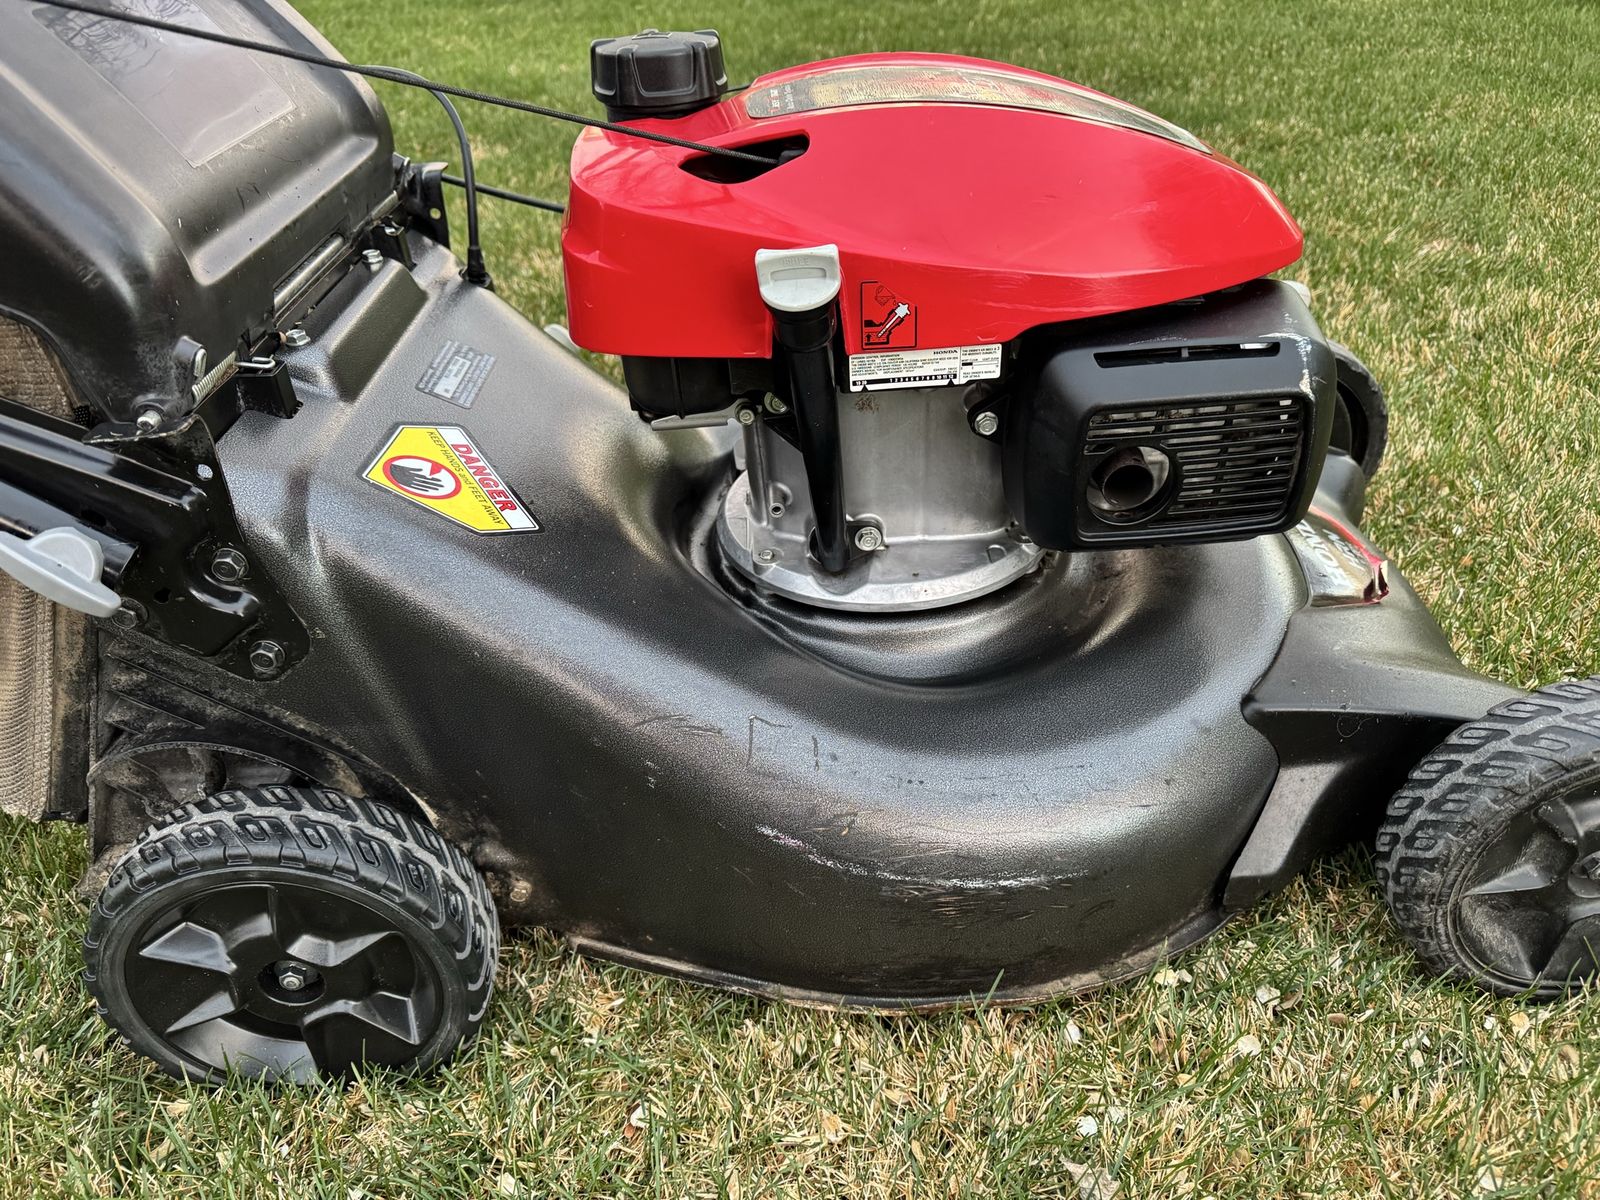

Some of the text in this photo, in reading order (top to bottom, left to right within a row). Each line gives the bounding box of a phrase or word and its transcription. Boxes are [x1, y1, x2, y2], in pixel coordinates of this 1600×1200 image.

[427, 431, 504, 524] KEEP HANDS and FEET AWAY
[450, 444, 517, 512] DANGER
